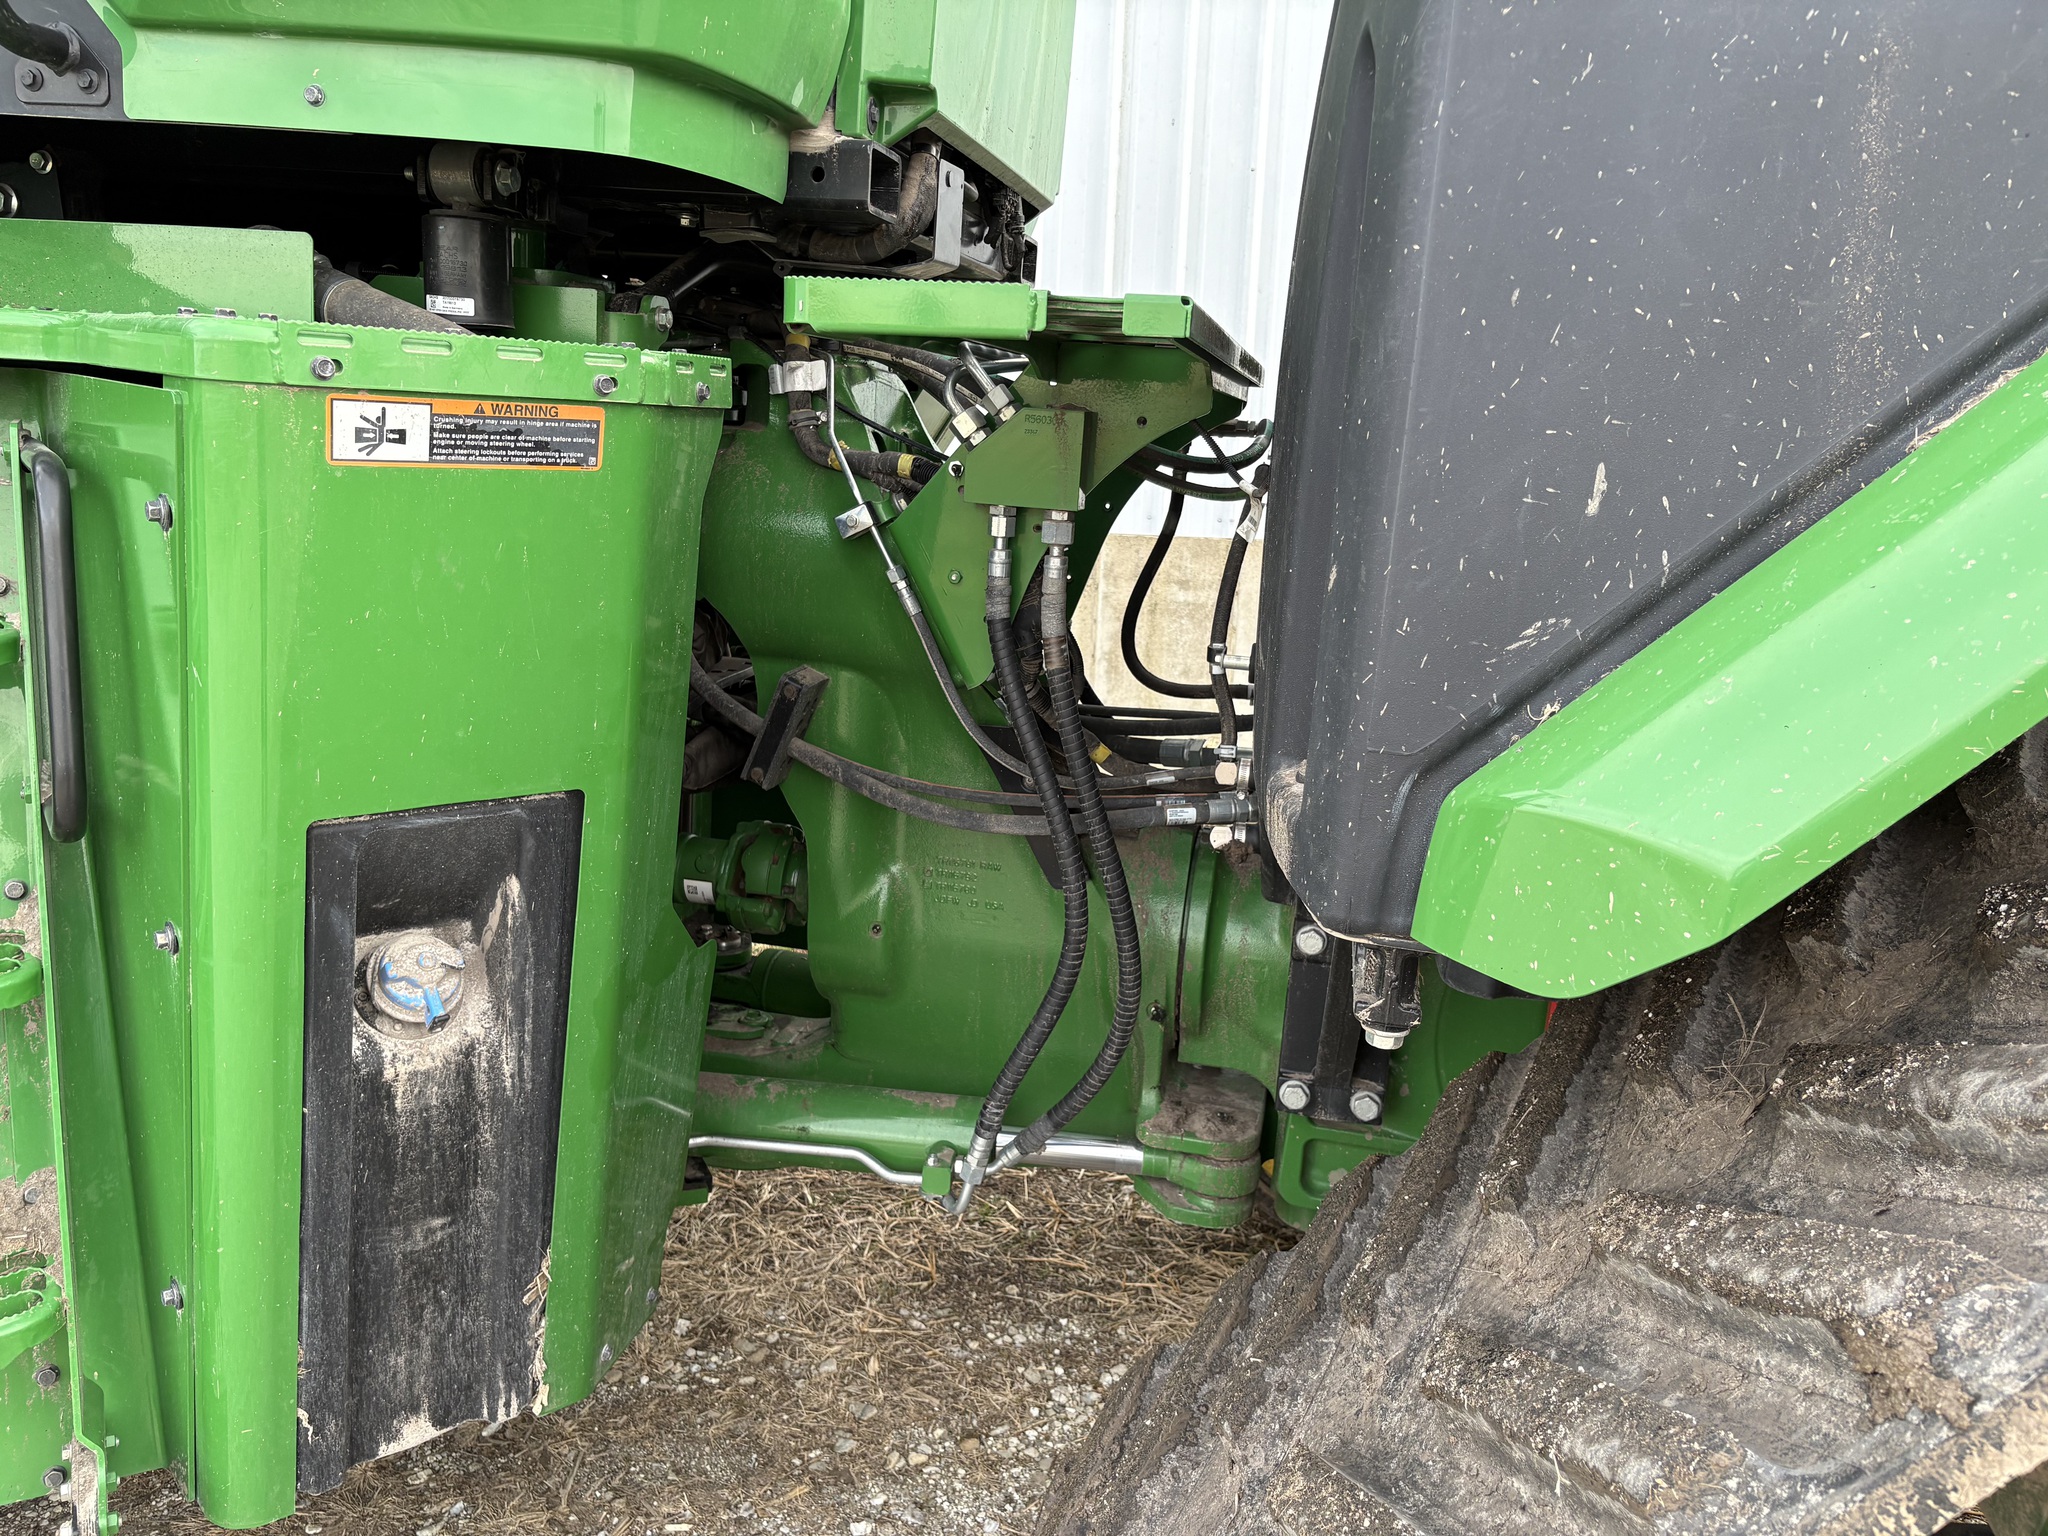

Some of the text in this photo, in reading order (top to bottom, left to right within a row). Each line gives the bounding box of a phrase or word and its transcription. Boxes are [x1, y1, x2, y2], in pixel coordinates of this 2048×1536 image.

[491, 403, 559, 418] WARNING
[433, 416, 464, 424] Crushing
[465, 417, 483, 425] injury
[467, 433, 489, 441] people
[527, 450, 559, 458] performing
[980, 860, 1002, 872] RAW
[984, 899, 1005, 911] USA
